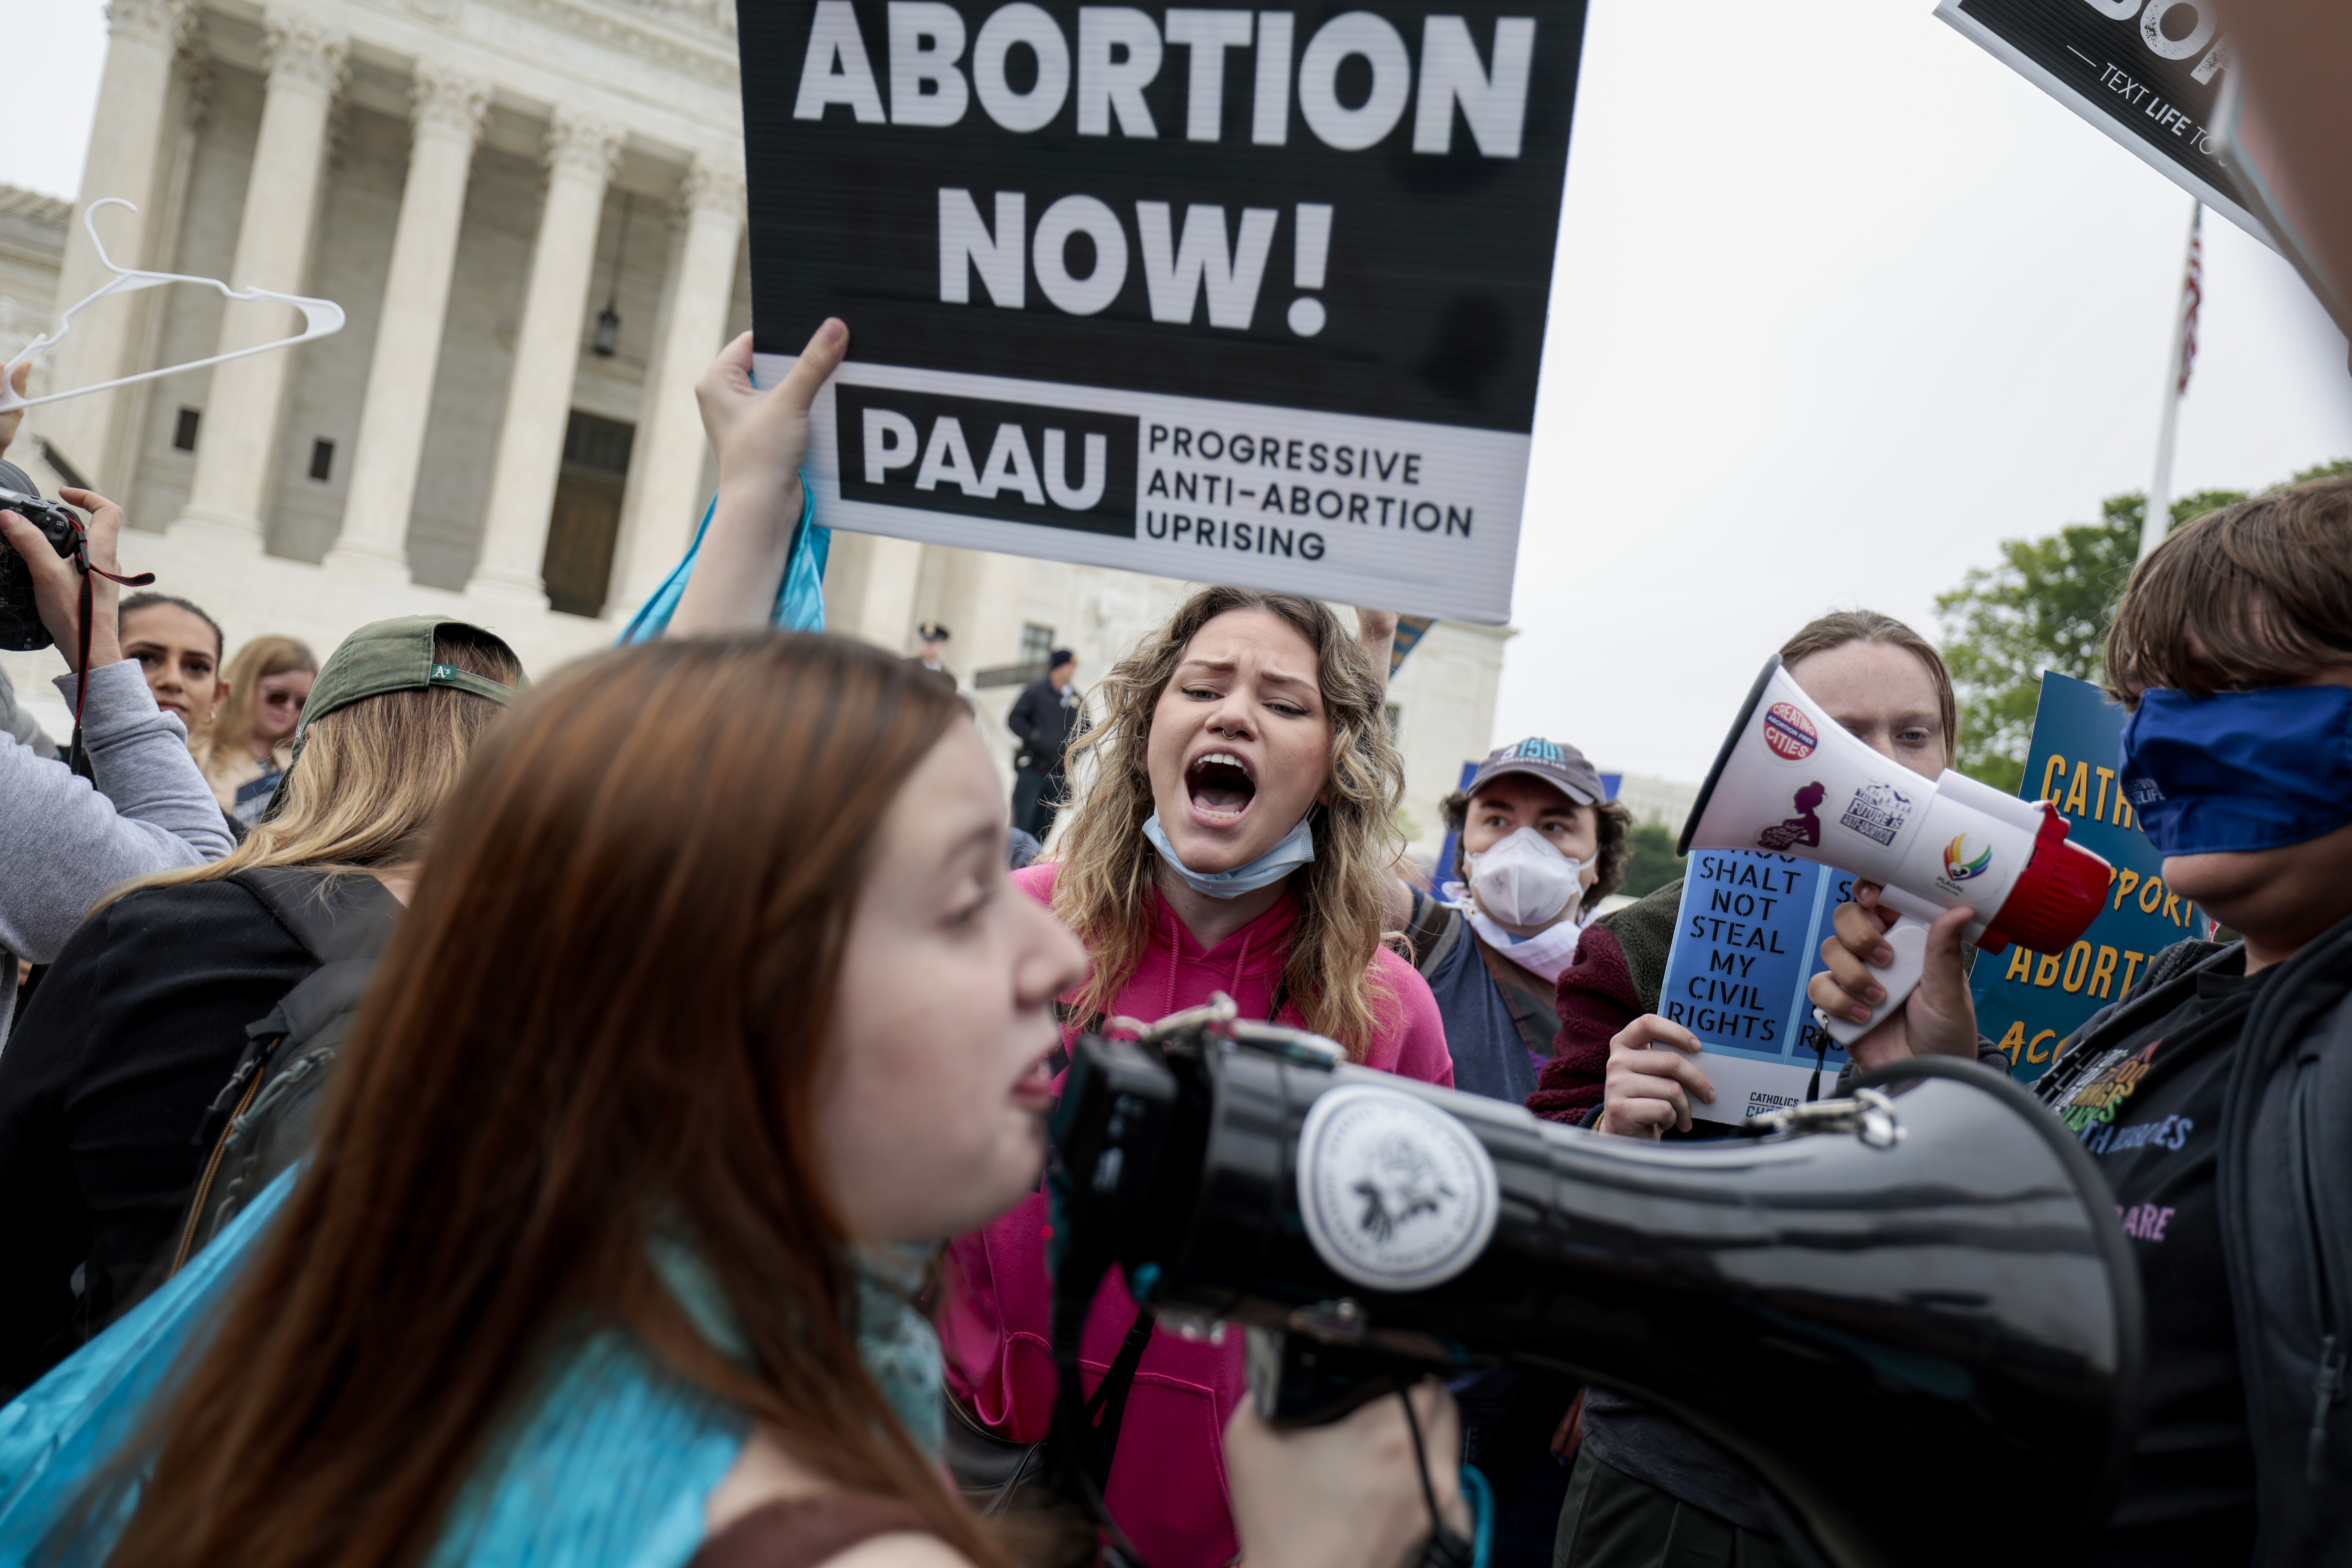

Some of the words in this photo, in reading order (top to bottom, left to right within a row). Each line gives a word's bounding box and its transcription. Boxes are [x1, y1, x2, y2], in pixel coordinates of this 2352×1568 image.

[793, 0, 1535, 159] ABORTION
[2100, 62, 2149, 104] TEXT
[2145, 97, 2191, 136] LIFE
[2190, 126, 2216, 154] TO
[938, 188, 1333, 337] NOW!
[862, 408, 1107, 511] PAAU
[1149, 424, 1421, 486] PROGRESSIVE
[1147, 468, 1473, 538] ANTI-ABORTION
[1146, 511, 1326, 561] UPRISING
[432, 666, 450, 678] A's
[1767, 715, 1798, 736] ABORTION
[1798, 733, 1815, 745] FREE
[1773, 704, 1815, 735] CREATING
[1518, 739, 1557, 761] 150
[1766, 727, 1809, 757] CITIES
[1858, 789, 1875, 804] THE
[2040, 754, 2144, 833] CATH
[1842, 815, 1893, 844] ANTI-ABORTION
[1848, 801, 1889, 826] FUTURE
[1888, 818, 1902, 829] IS
[1700, 856, 1801, 894] SHALT
[1936, 876, 1965, 893] PLAGAL
[1711, 888, 1777, 920] NOT
[1690, 915, 1784, 954] STEAL
[1710, 949, 1756, 978] MY
[2005, 940, 2156, 1000] ABORT
[1688, 976, 1764, 1011] CIVIL
[1668, 1001, 1776, 1041] RIGHTS
[1750, 1092, 1799, 1107] CATHOLICS
